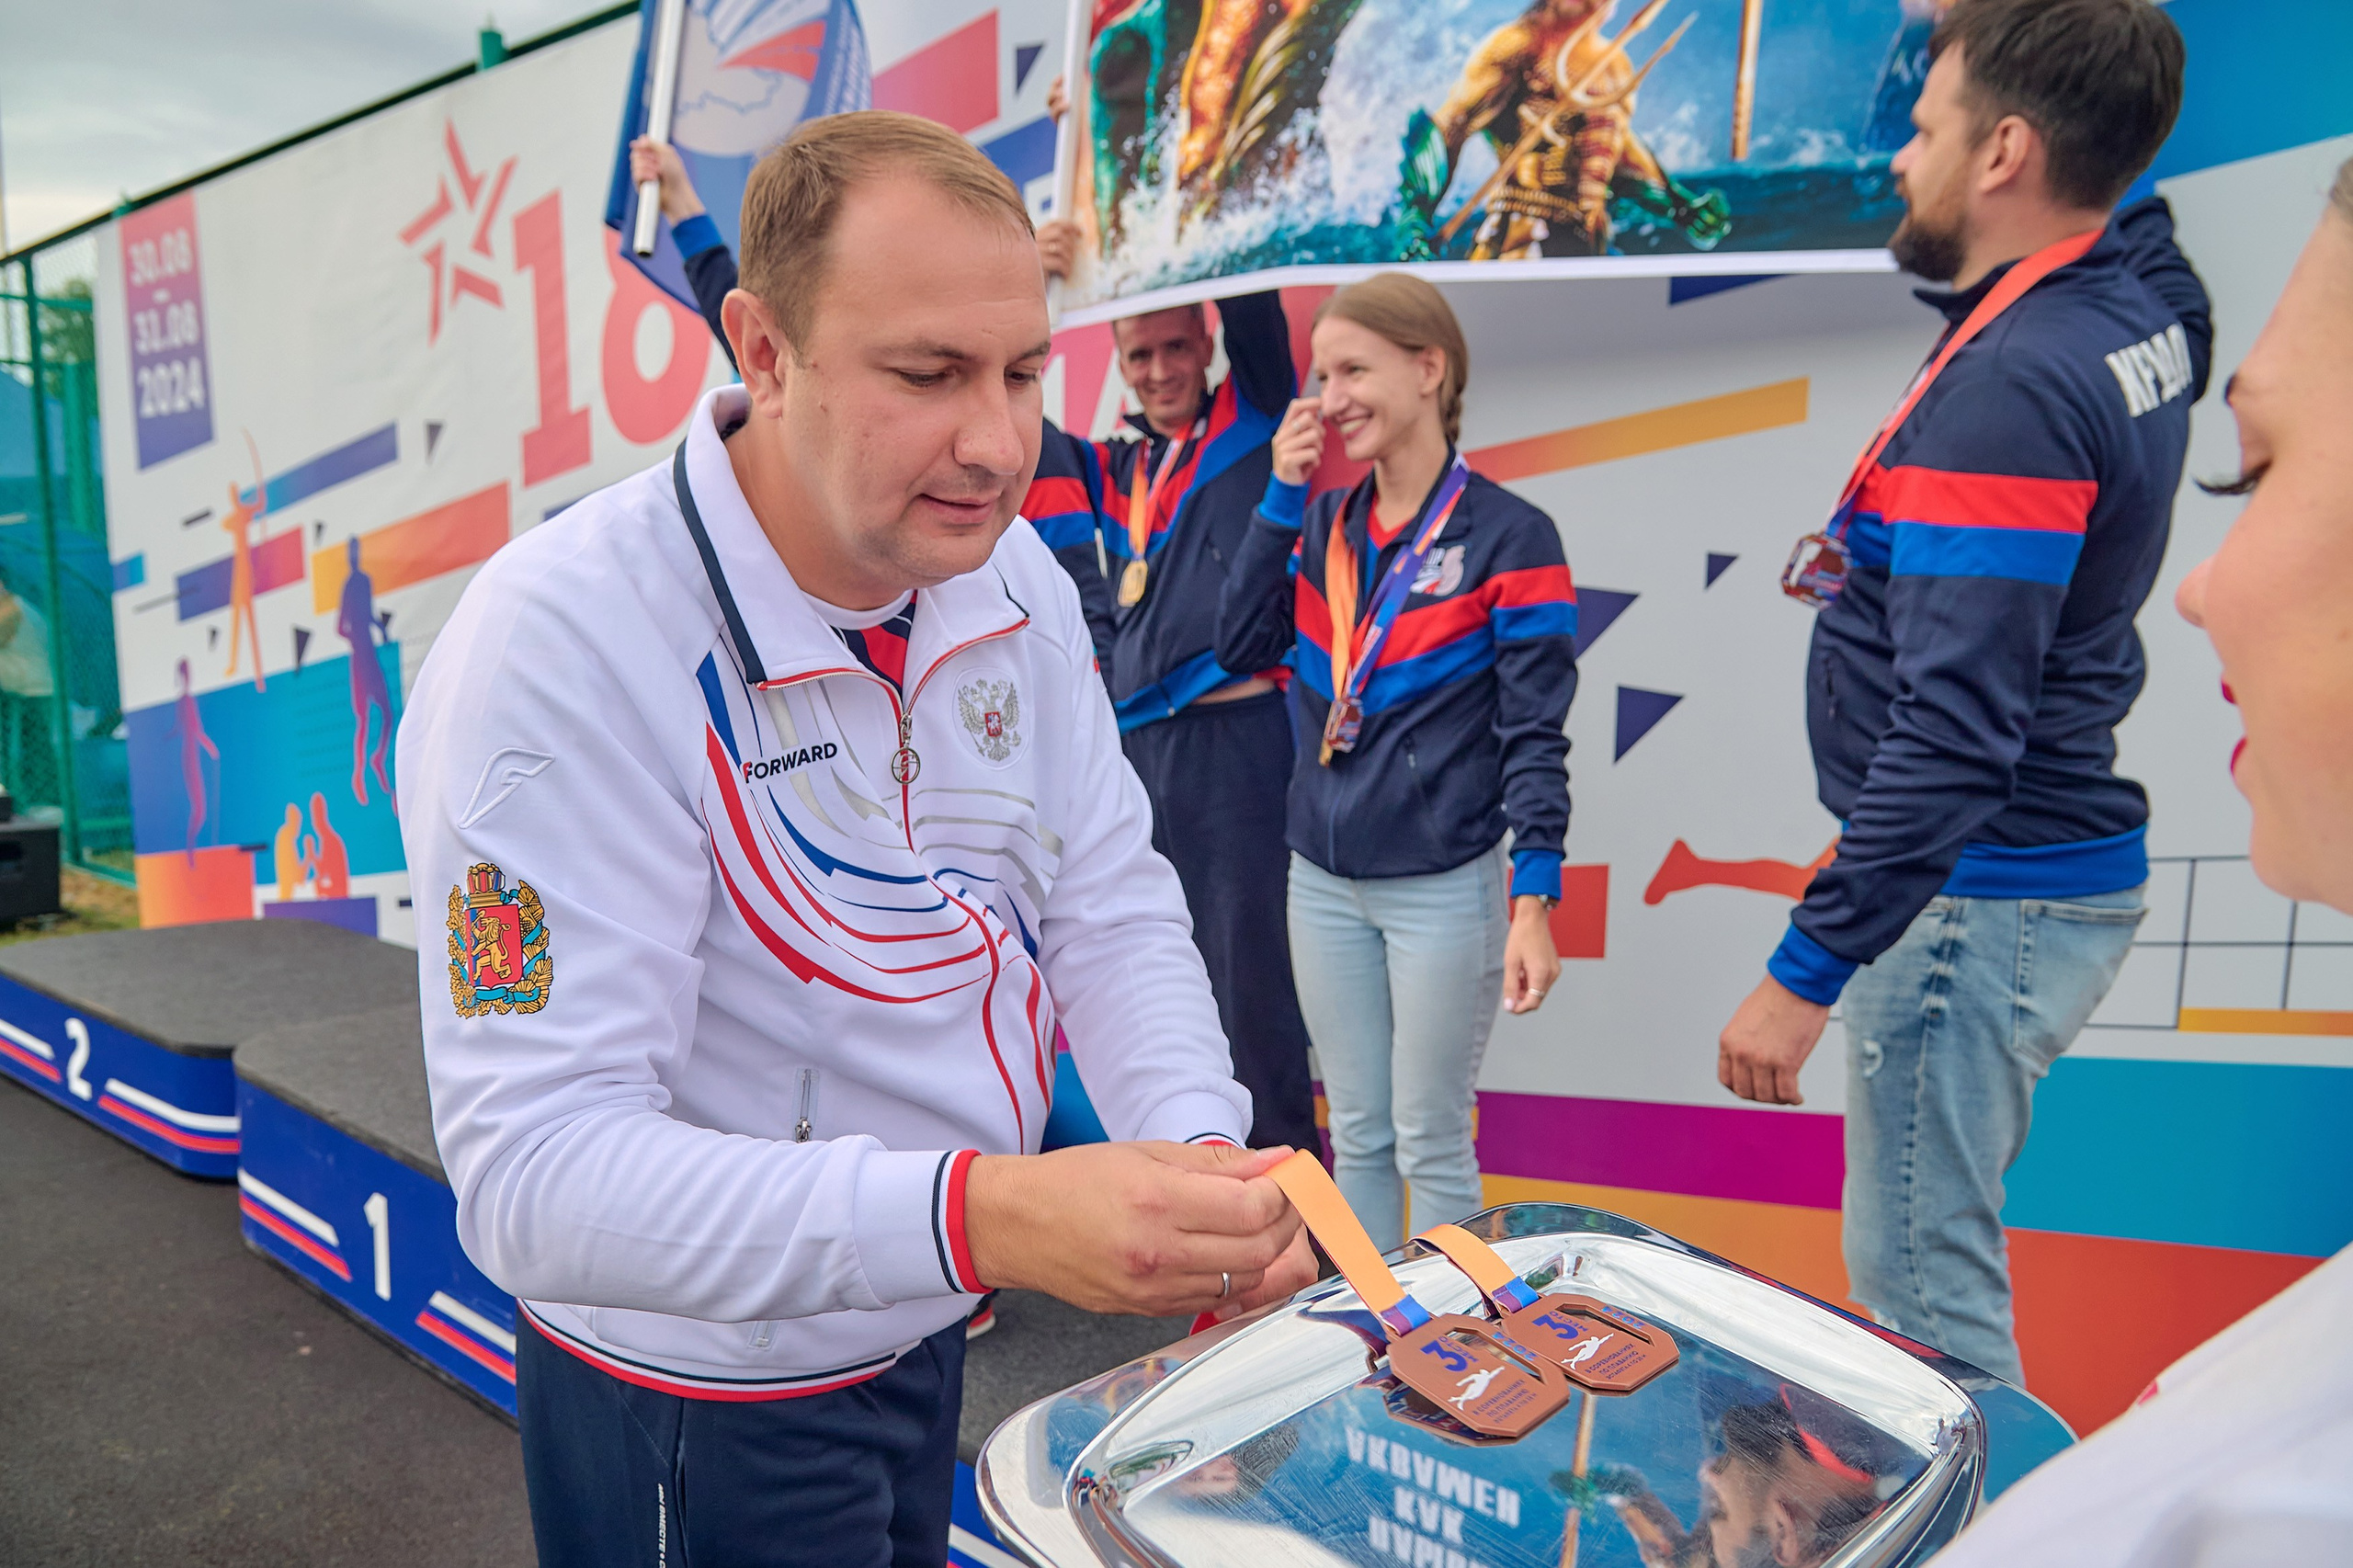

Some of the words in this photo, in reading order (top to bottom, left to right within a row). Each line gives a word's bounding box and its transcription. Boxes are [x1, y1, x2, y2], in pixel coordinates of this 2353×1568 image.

[513, 187, 714, 490] 18
[138, 357, 204, 418] 2024
[743, 743, 837, 784] FORWARD
[64, 1017, 92, 1101] 2
[364, 1192, 392, 1301] 1
[1531, 1313, 1579, 1339] 3
[1549, 1311, 1589, 1333] МЕСТО
[1601, 1306, 1645, 1330] 2024
[1420, 1339, 1468, 1372] 3
[1438, 1335, 1479, 1363] МЕСТО
[1491, 1331, 1539, 1362] 2024
[1589, 1343, 1634, 1371] СОРЕВНОВАНИЯХ
[658, 1504, 666, 1553] ВМЕСТЕ
